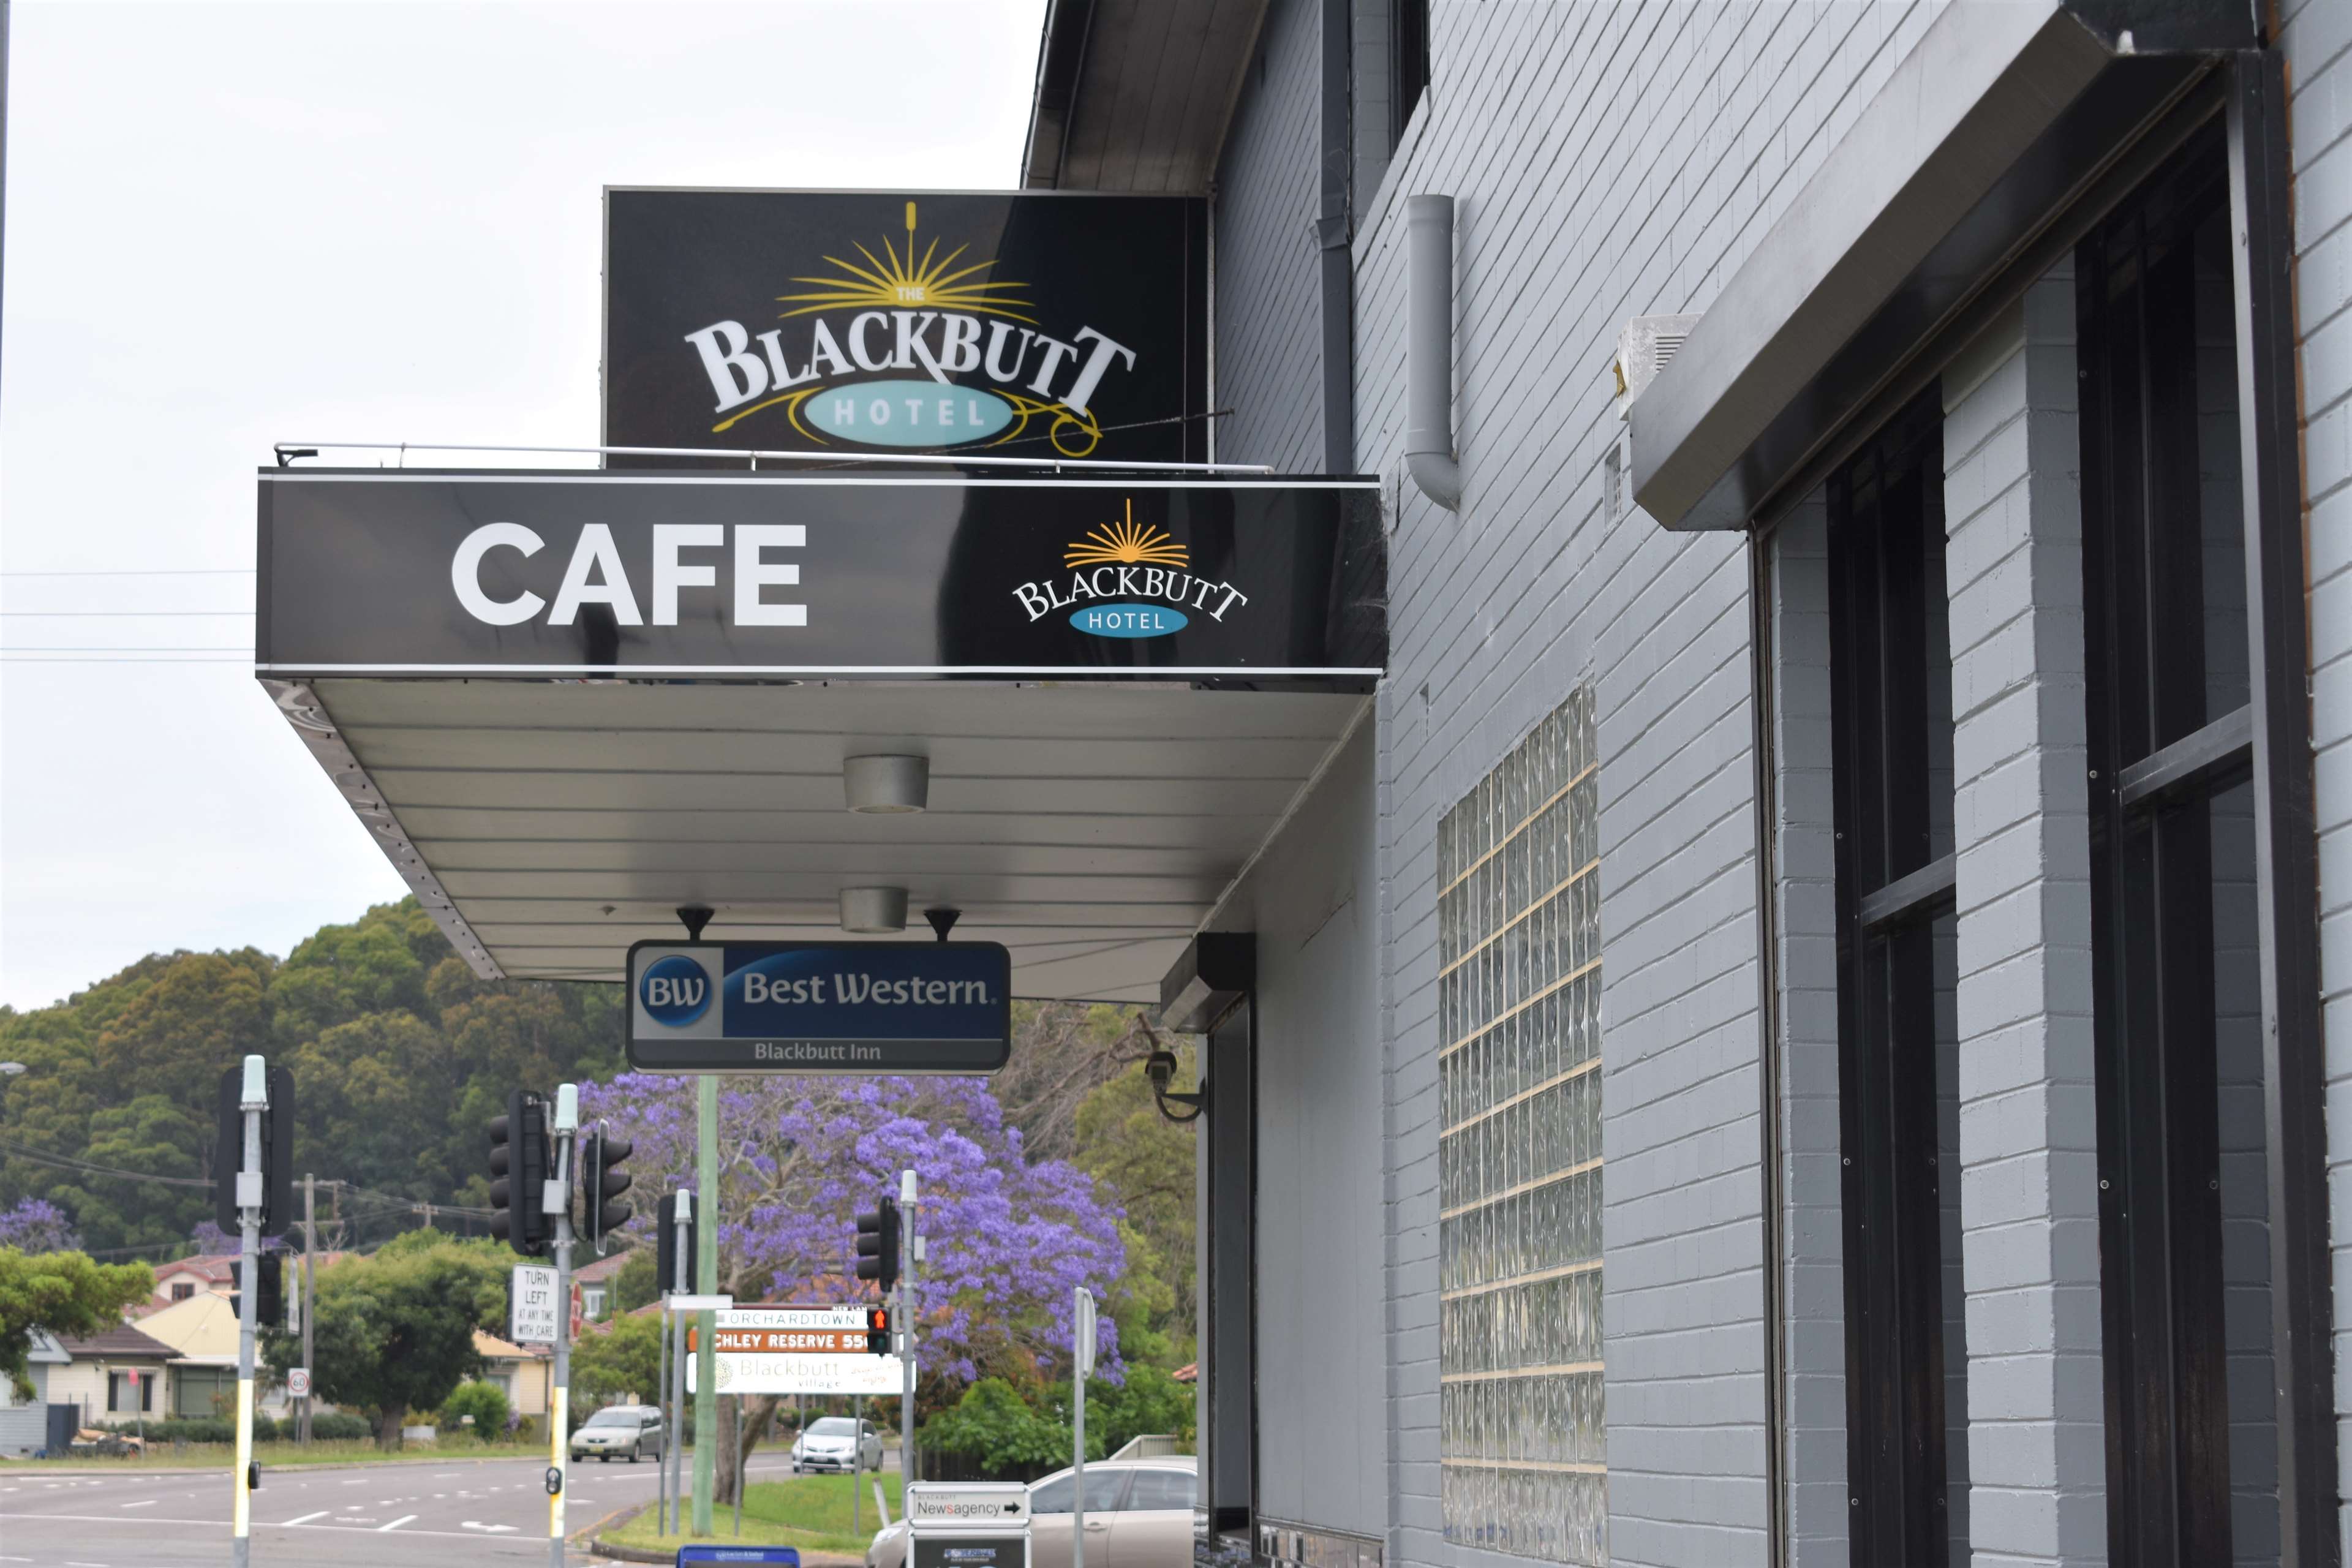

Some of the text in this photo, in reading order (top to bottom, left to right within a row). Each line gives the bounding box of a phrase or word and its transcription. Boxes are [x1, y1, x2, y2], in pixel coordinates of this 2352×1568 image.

[896, 287, 925, 301] THE
[684, 309, 1137, 418] BLACKBUTT
[834, 399, 984, 427] HOTEL
[452, 522, 807, 626] CAFE
[1012, 566, 1248, 623] BLACKBUTT
[1089, 613, 1164, 629] HOTEL
[648, 977, 704, 1007] BW
[744, 973, 989, 1005] Best Western
[755, 1043, 881, 1060] Blackbutt Inn
[525, 1270, 549, 1286] TURN
[525, 1290, 548, 1304] LEFT
[729, 1313, 856, 1325] ORCHARDTOWN
[518, 1324, 554, 1337] WITH CARE
[715, 1333, 762, 1348] CHLEY
[767, 1333, 835, 1348] RESERVE
[740, 1358, 839, 1376] Blackbutt
[293, 1377, 305, 1387] 60
[798, 1379, 841, 1389] village
[918, 1501, 1000, 1517] Newsagency
